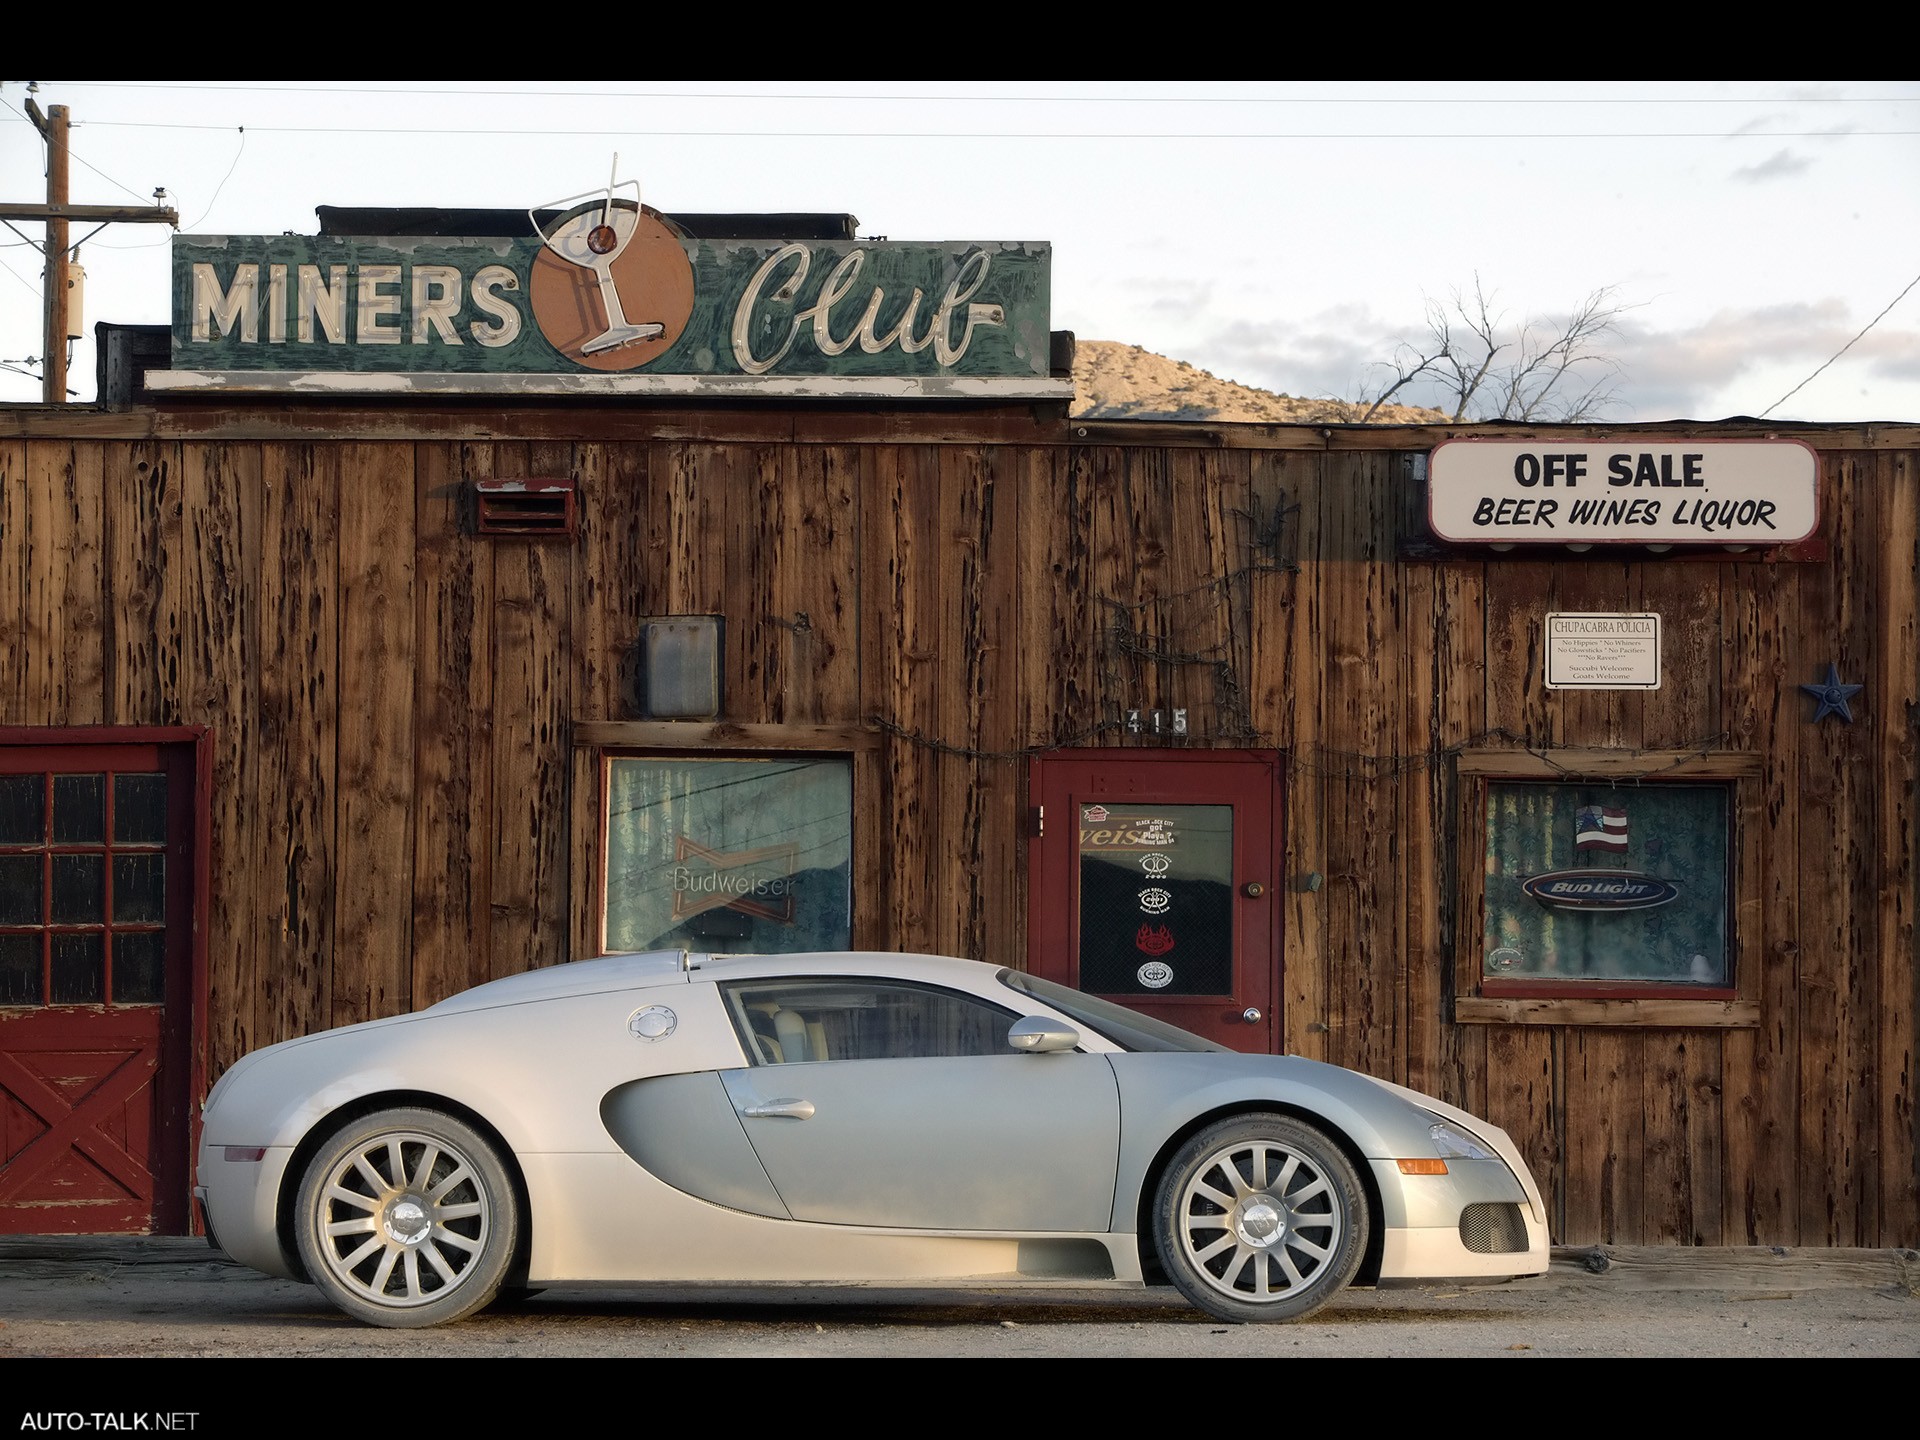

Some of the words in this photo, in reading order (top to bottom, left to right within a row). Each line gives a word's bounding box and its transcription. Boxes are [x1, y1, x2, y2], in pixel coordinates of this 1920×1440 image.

[192, 262, 522, 347] MINERS
[731, 243, 1005, 375] Club
[1514, 453, 1588, 487] OFF
[1608, 453, 1704, 488] SALE
[1472, 497, 1559, 528] BEER
[1568, 498, 1661, 526] WINES
[1672, 499, 1777, 532] LIQUOR
[1555, 621, 1614, 633] CHUPACABRA
[1616, 621, 1651, 633] POLICIA
[1143, 831, 1165, 840] Playa
[673, 866, 796, 896] Budweiser
[1550, 882, 1593, 894] BUD
[1593, 882, 1648, 894] LIGHT
